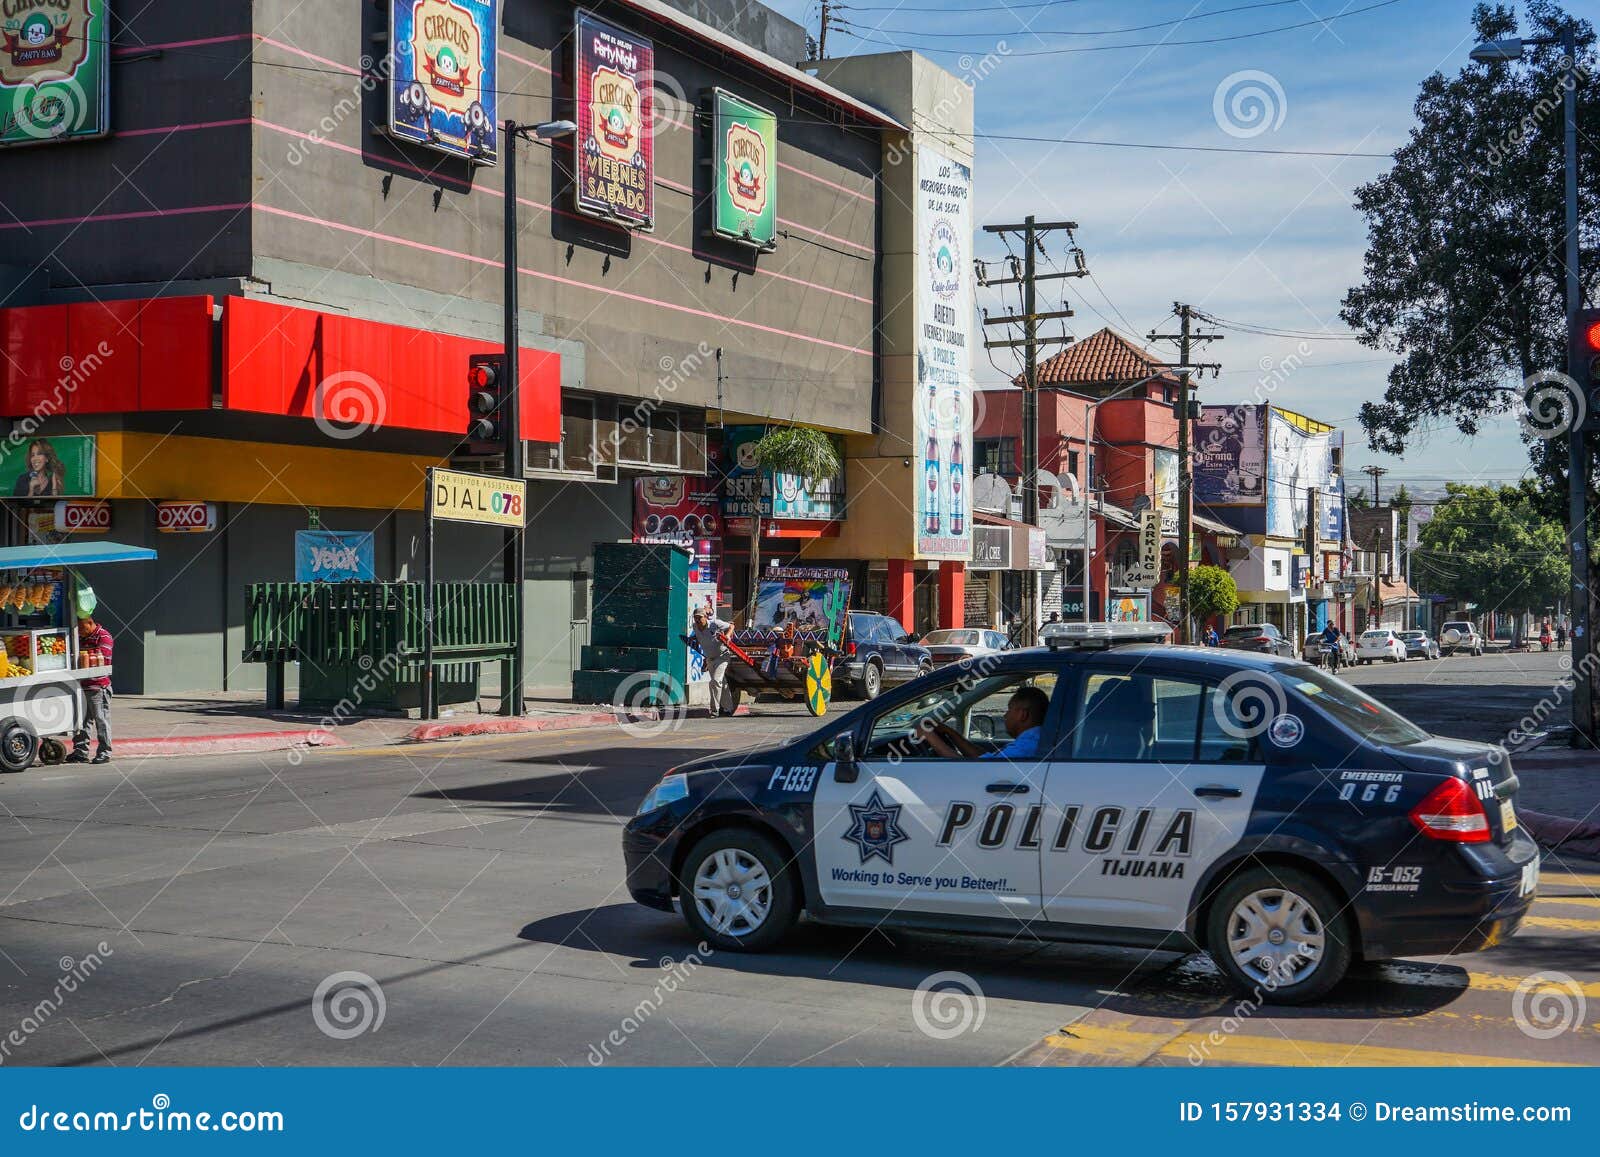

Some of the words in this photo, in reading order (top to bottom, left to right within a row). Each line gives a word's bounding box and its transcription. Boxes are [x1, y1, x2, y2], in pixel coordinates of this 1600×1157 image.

[424, 15, 470, 53] CIRCUS
[593, 37, 615, 64] Party
[615, 47, 637, 70] Night
[599, 83, 633, 113] CIRCUS
[732, 139, 760, 167] CIRCUS
[587, 154, 646, 190] VIERNES
[938, 166, 950, 178] LOS
[587, 177, 646, 213] SABADO
[928, 199, 936, 210] DE
[935, 201, 943, 211] LA
[933, 303, 956, 326] ABIERTO
[924, 323, 942, 342] VIERNES
[437, 473, 450, 482] FOR
[453, 476, 480, 486] VISITOR
[483, 481, 522, 492] ASSISTANCE
[436, 484, 487, 511] DIAL
[491, 491, 522, 516] 078
[726, 502, 739, 513] NO
[741, 502, 770, 514] COER
[67, 508, 110, 524] OXXO
[158, 507, 205, 527] OXXO
[1144, 514, 1157, 570] PARKING
[1127, 573, 1142, 583] 24
[768, 765, 818, 793] P-1333
[1339, 771, 1403, 782] EMERGENCIA
[935, 799, 1197, 857] POLICIA
[831, 867, 879, 886] Working
[882, 873, 895, 886] to
[897, 873, 932, 887] Serve
[934, 877, 959, 890] you
[1101, 859, 1185, 879] TIJUANA
